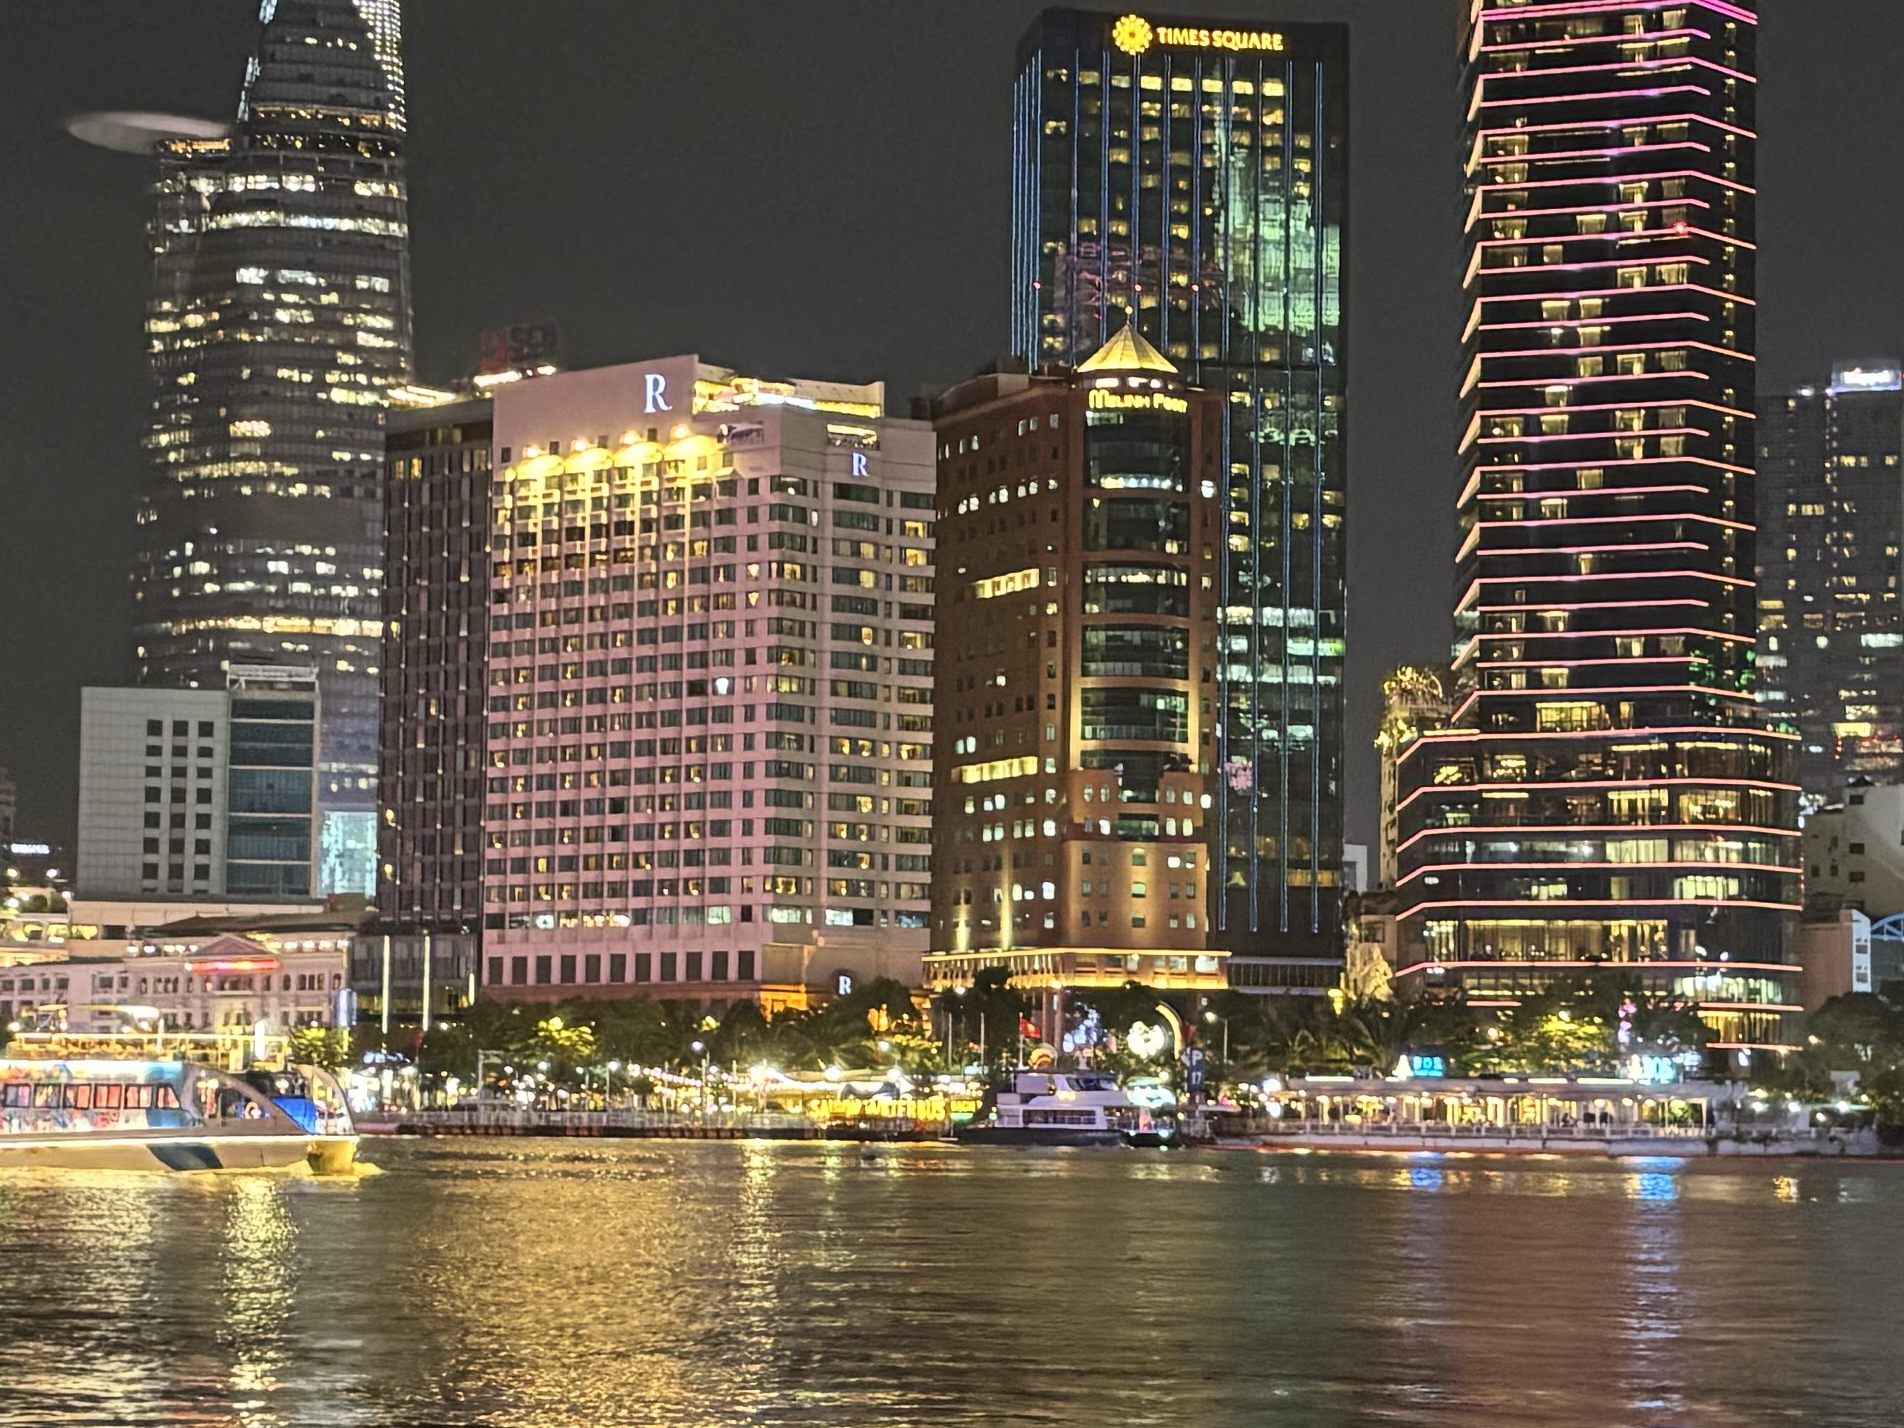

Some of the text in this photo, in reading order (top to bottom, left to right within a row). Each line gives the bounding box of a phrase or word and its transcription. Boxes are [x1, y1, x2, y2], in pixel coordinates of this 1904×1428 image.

[1157, 27, 1284, 51] TIMES SQUARE
[644, 374, 672, 414] R
[852, 452, 869, 477] R
[838, 974, 852, 996] R
